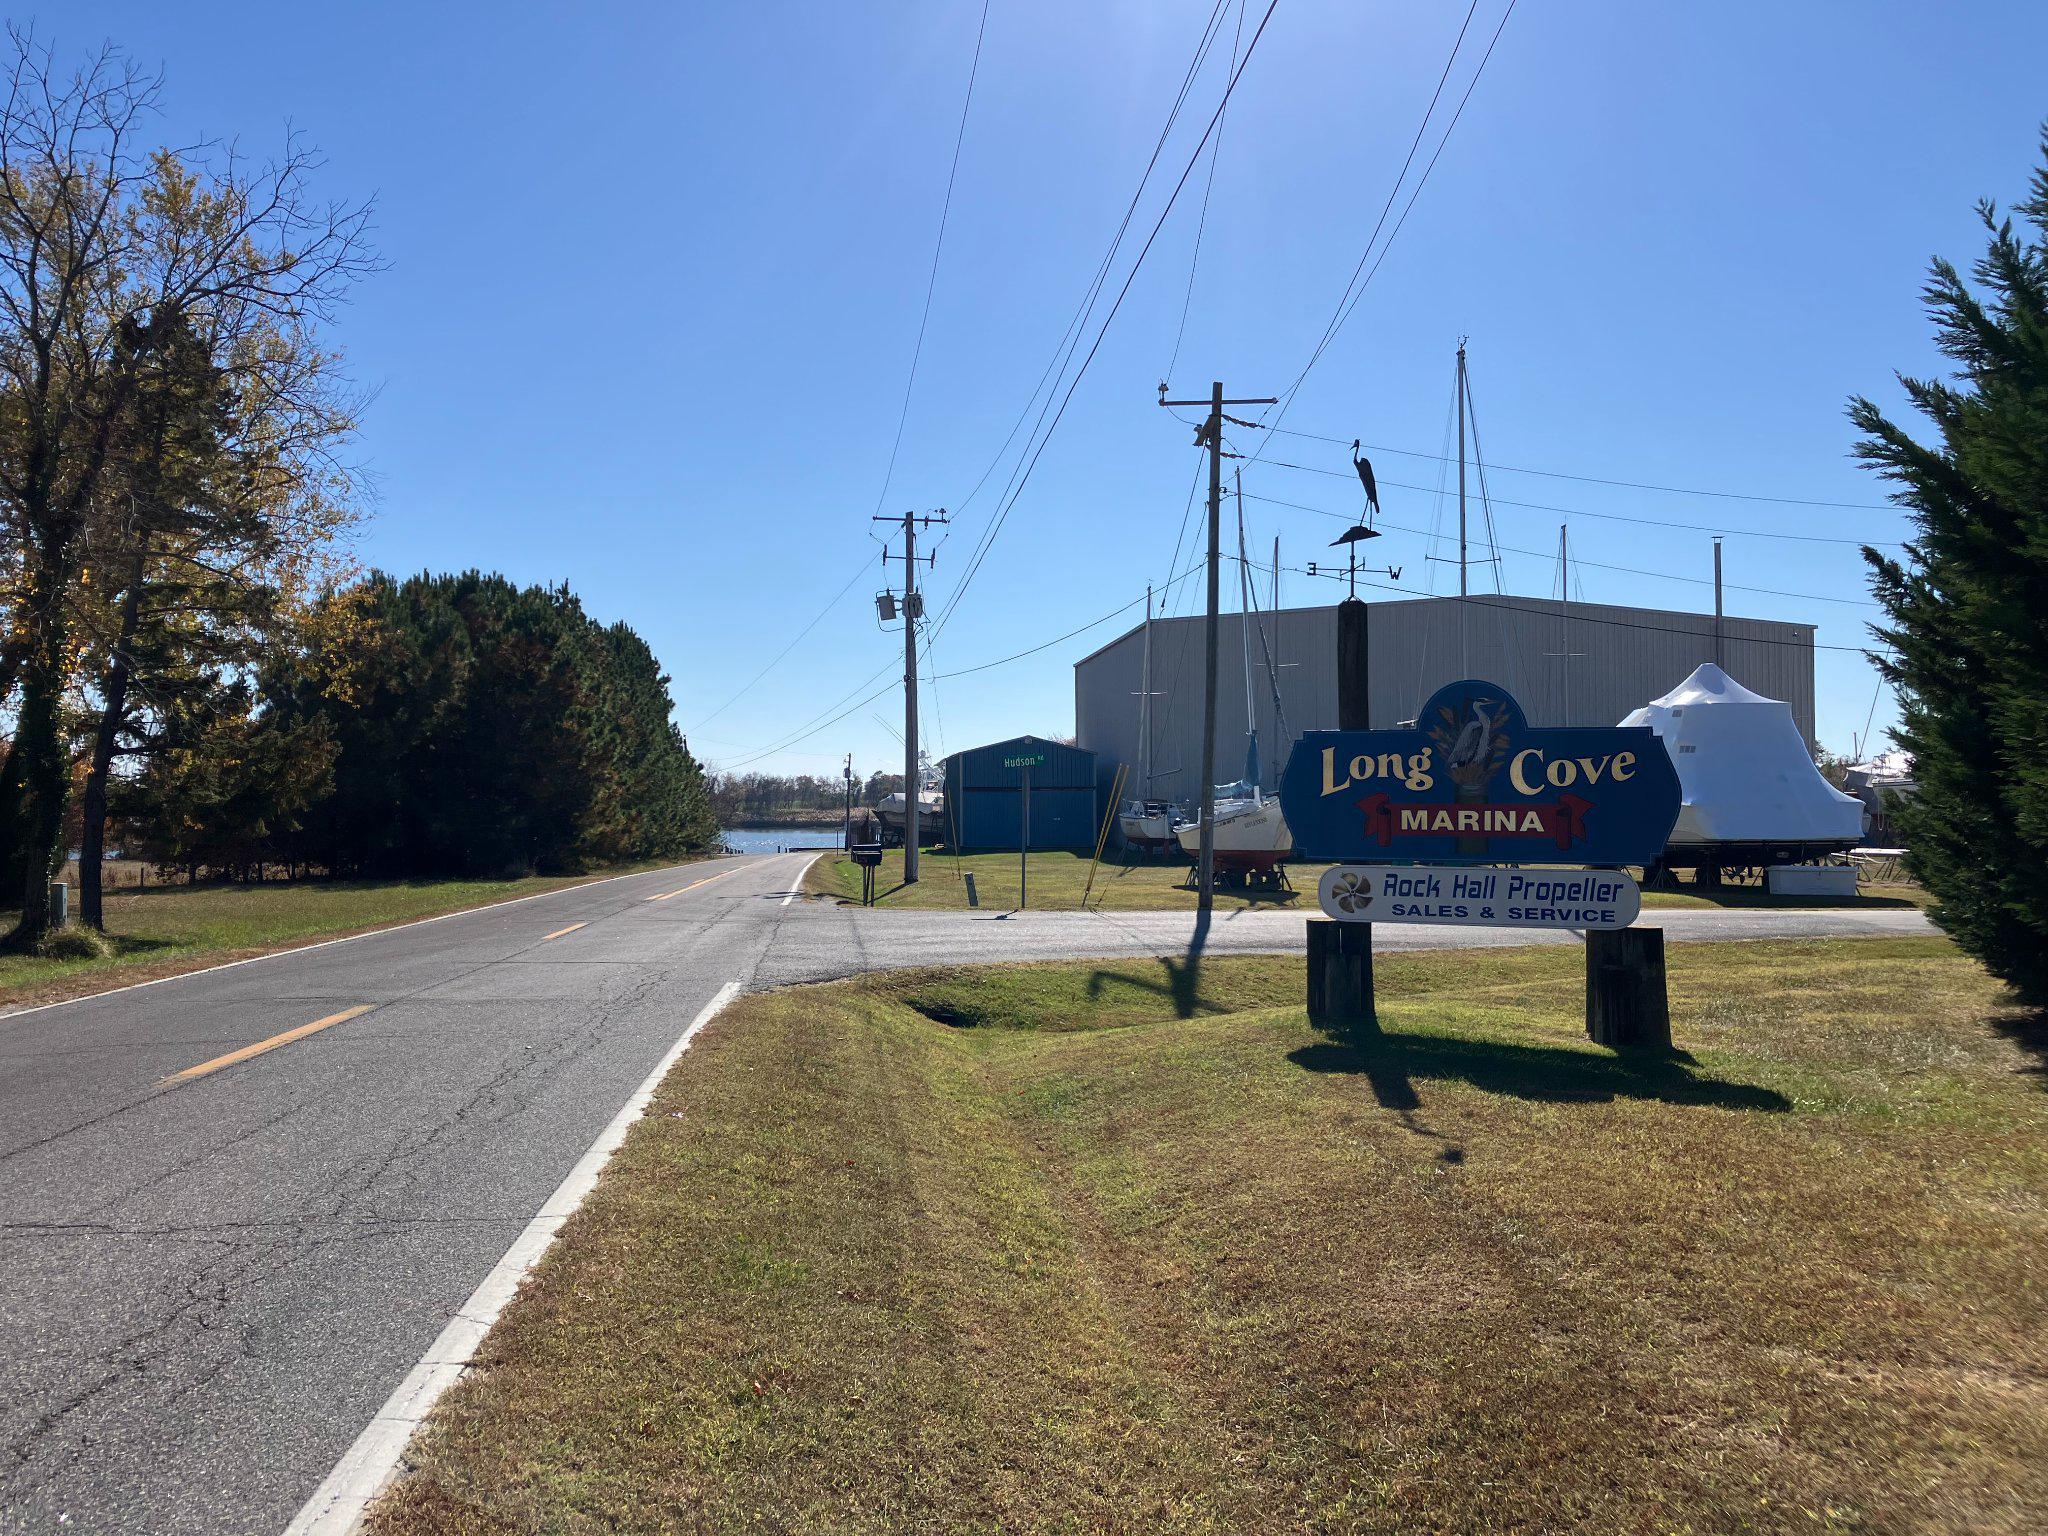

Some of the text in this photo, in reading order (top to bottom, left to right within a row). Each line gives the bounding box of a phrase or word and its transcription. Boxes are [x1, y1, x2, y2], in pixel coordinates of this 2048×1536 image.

[1388, 565, 1402, 580] W
[1004, 757, 1036, 768] Hudson
[1320, 746, 1636, 797] Long Cove
[1401, 809, 1545, 832] MARINA
[1383, 873, 1624, 907] Rock Hall Propeller
[1391, 903, 1616, 923] SALES & SERVICE
